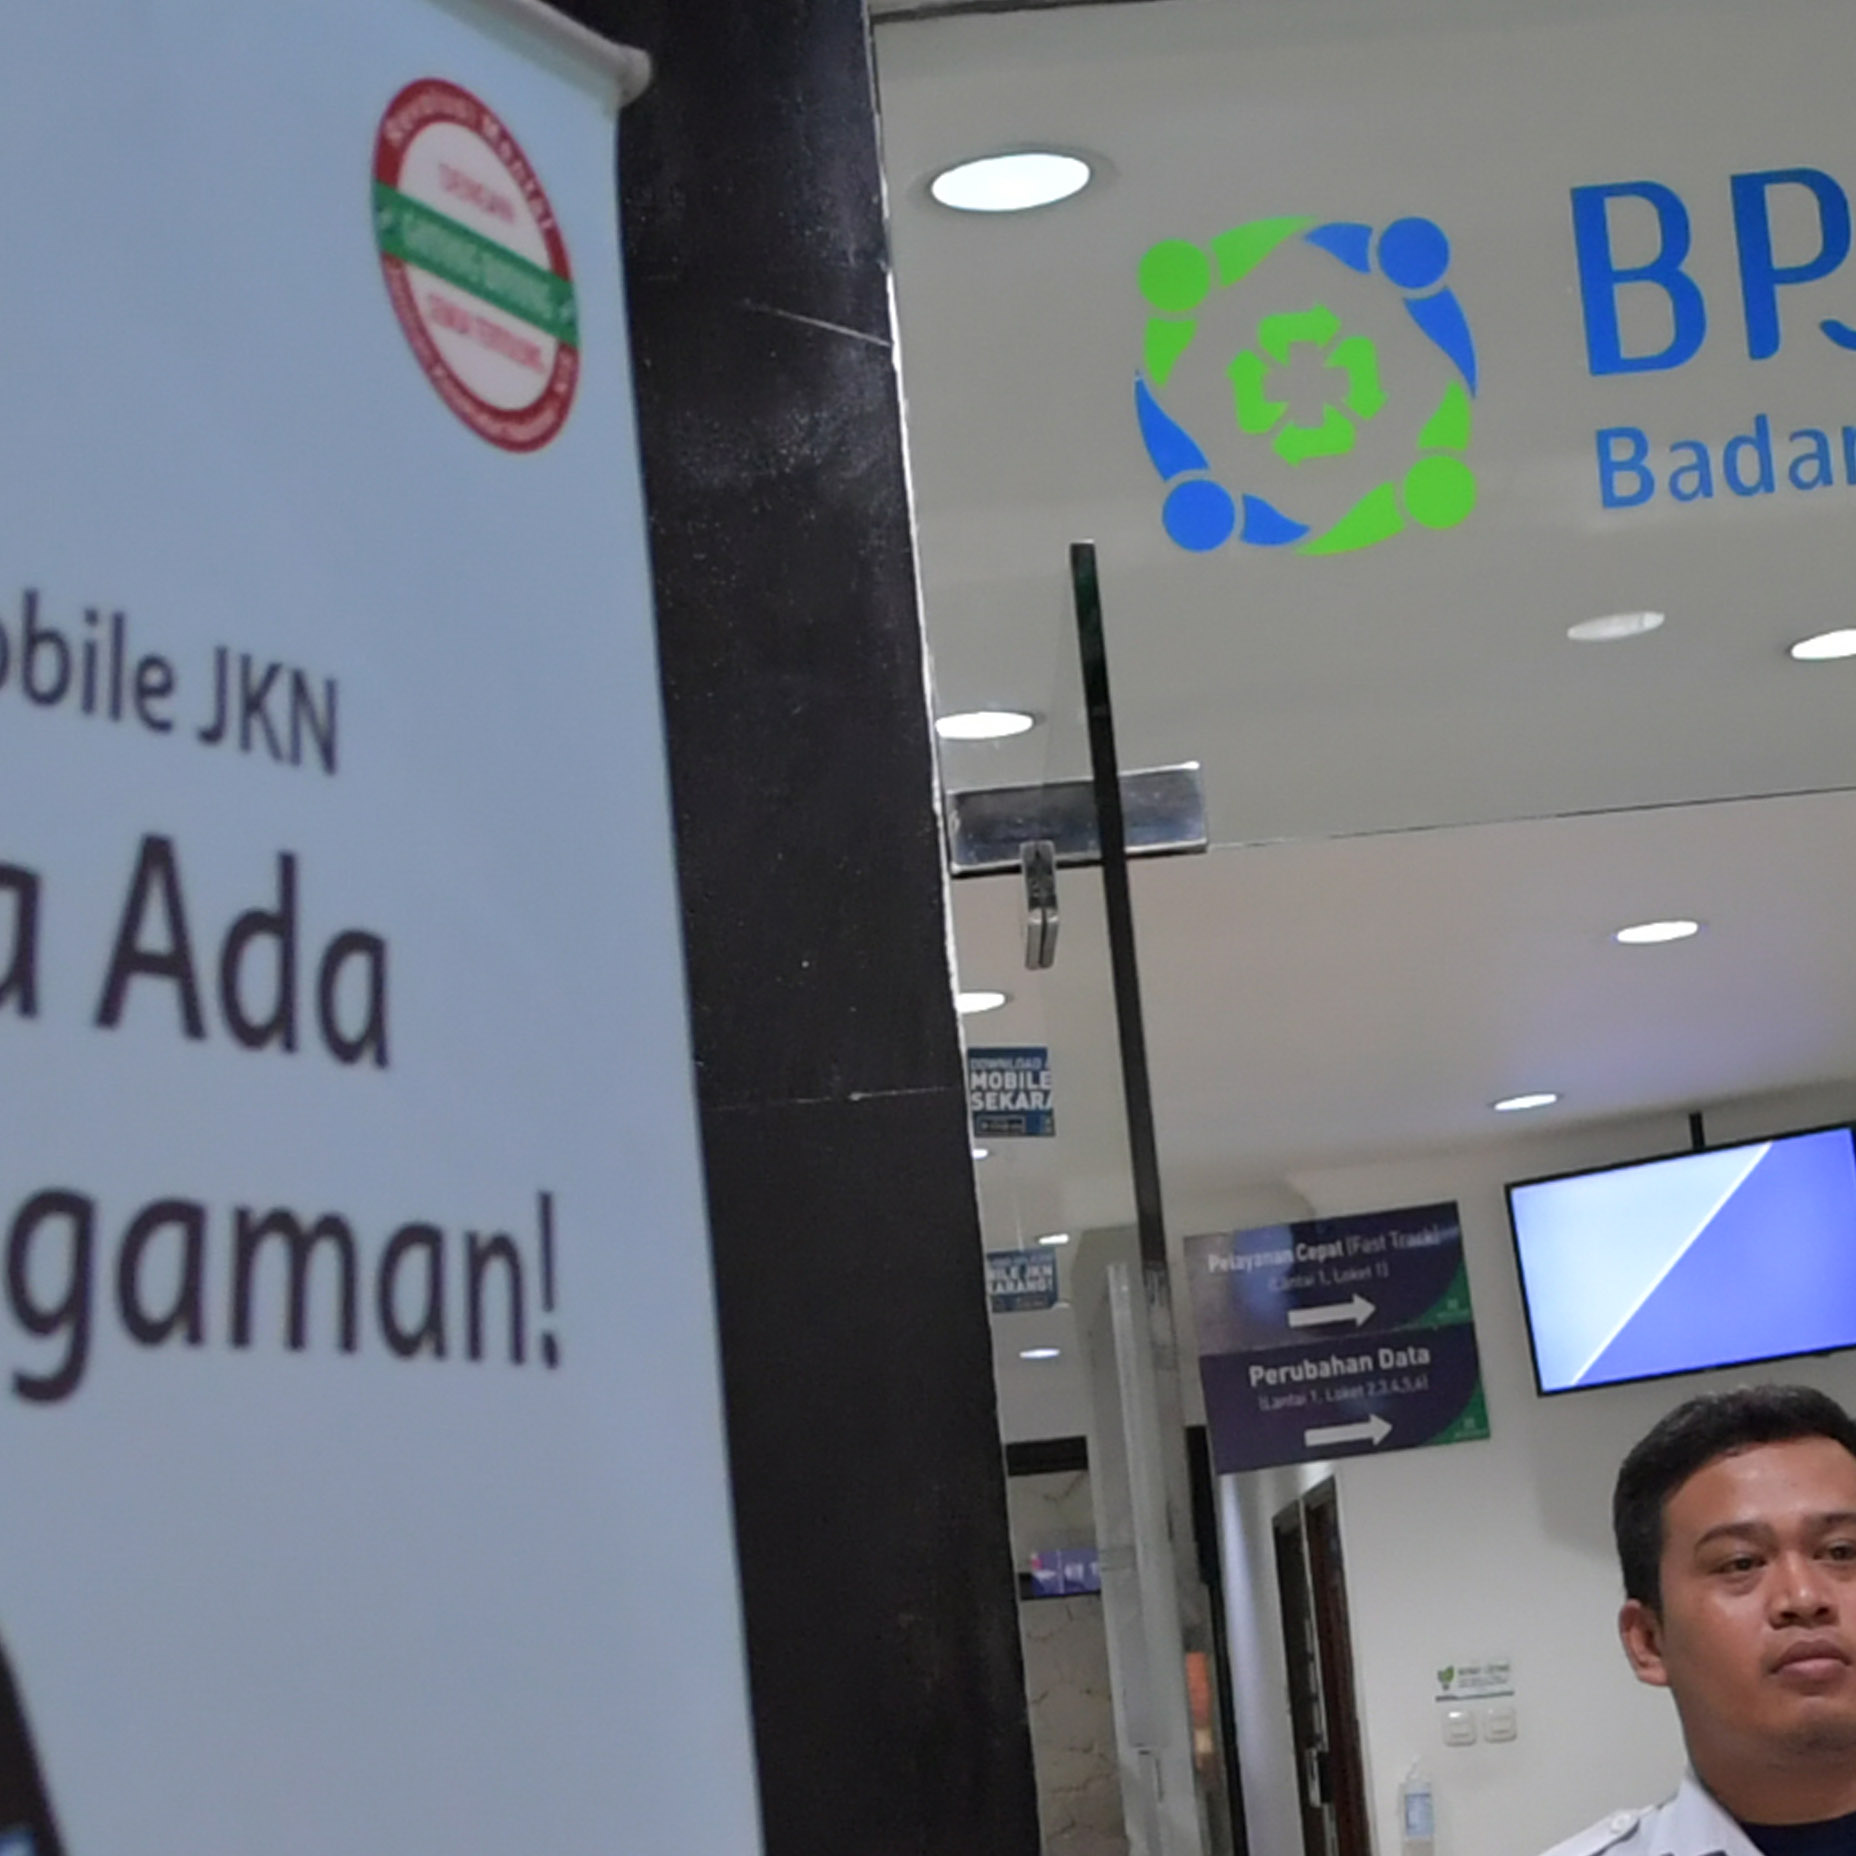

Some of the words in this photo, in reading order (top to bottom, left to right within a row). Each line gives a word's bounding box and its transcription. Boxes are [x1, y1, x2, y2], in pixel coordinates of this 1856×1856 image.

[195, 645, 341, 777] JKN
[91, 834, 393, 1071] Ada
[970, 1071, 1053, 1091] MOBILE
[1207, 1246, 1294, 1274] Pelayanan
[1296, 1241, 1344, 1263] Cepat
[1249, 1355, 1374, 1388] Perubahan
[1378, 1346, 1432, 1370] Data
